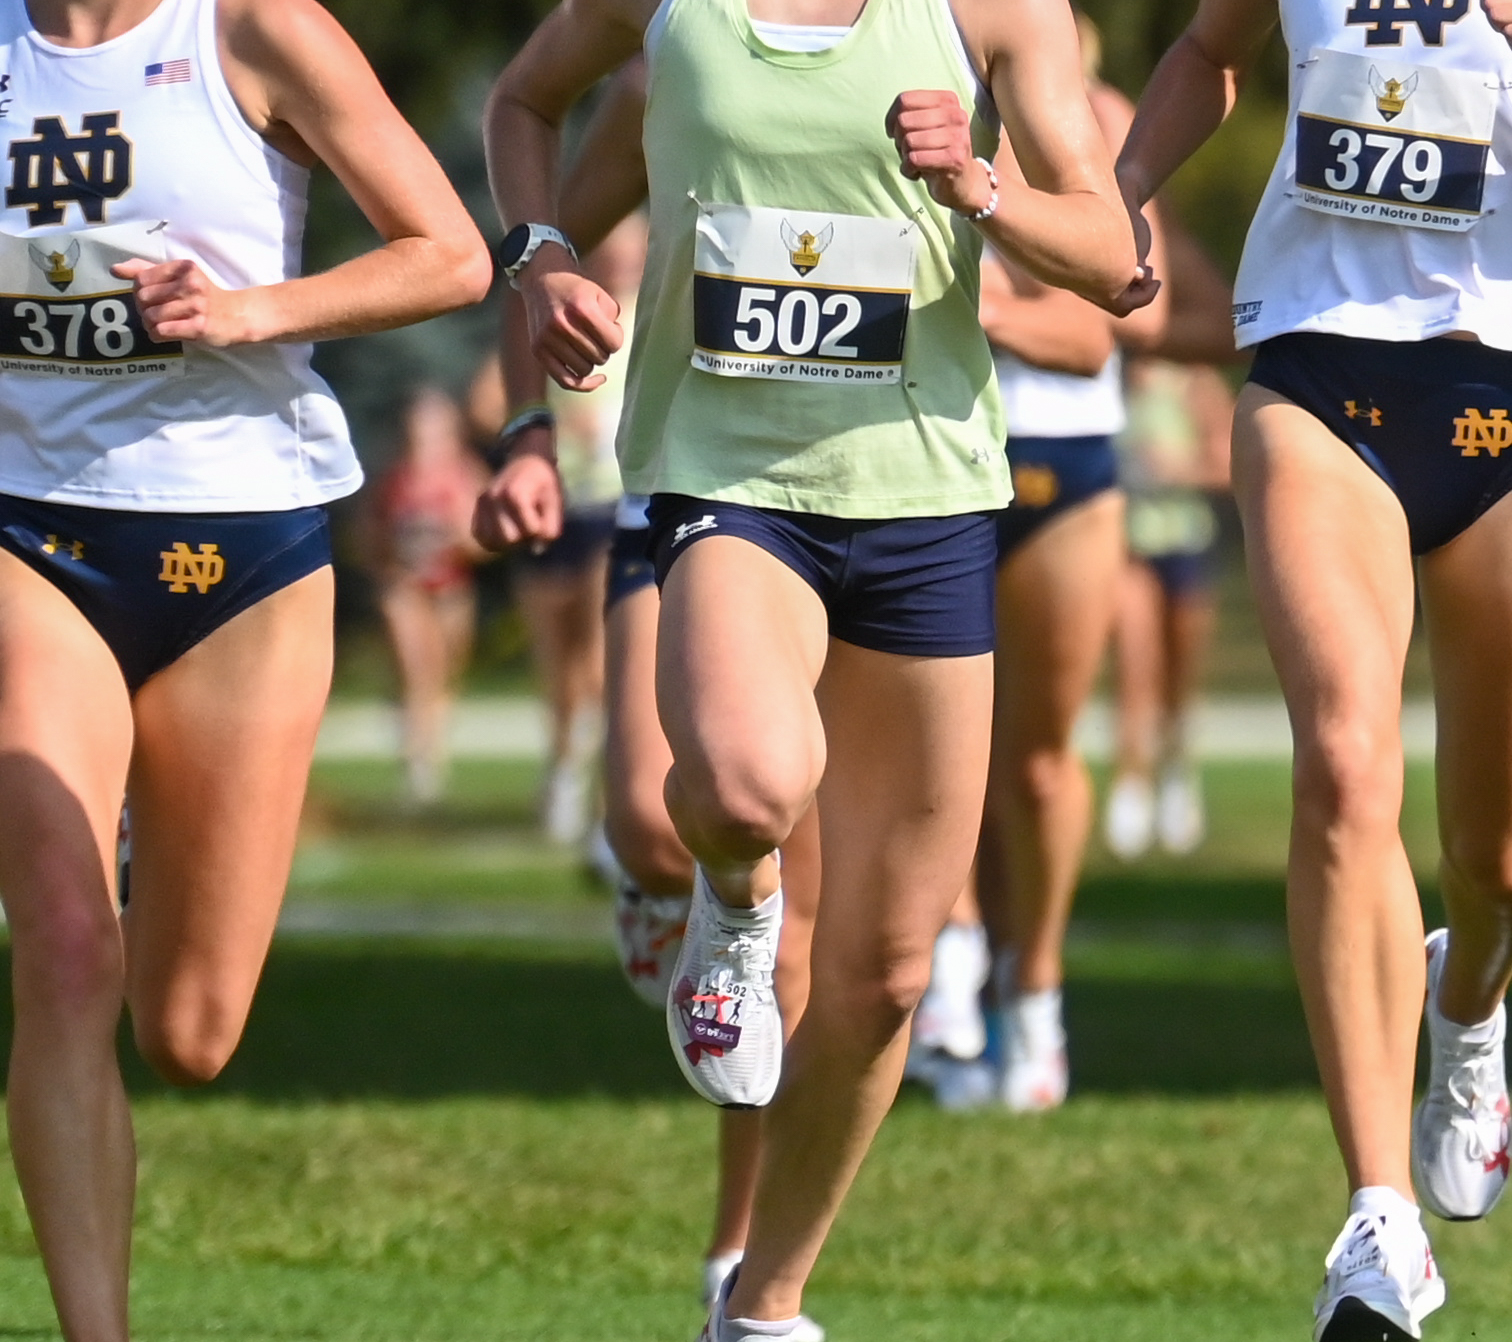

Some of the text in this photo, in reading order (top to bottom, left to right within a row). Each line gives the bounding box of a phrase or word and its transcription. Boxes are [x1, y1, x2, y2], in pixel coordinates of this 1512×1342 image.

[1323, 128, 1444, 203] 379
[1303, 191, 1460, 226] University of Notre Dame
[13, 298, 135, 359] 378
[732, 287, 862, 358] 502
[0, 360, 167, 376] University of Notre Dame
[706, 356, 884, 379] University of Notre Dame
[726, 982, 747, 998] 502
